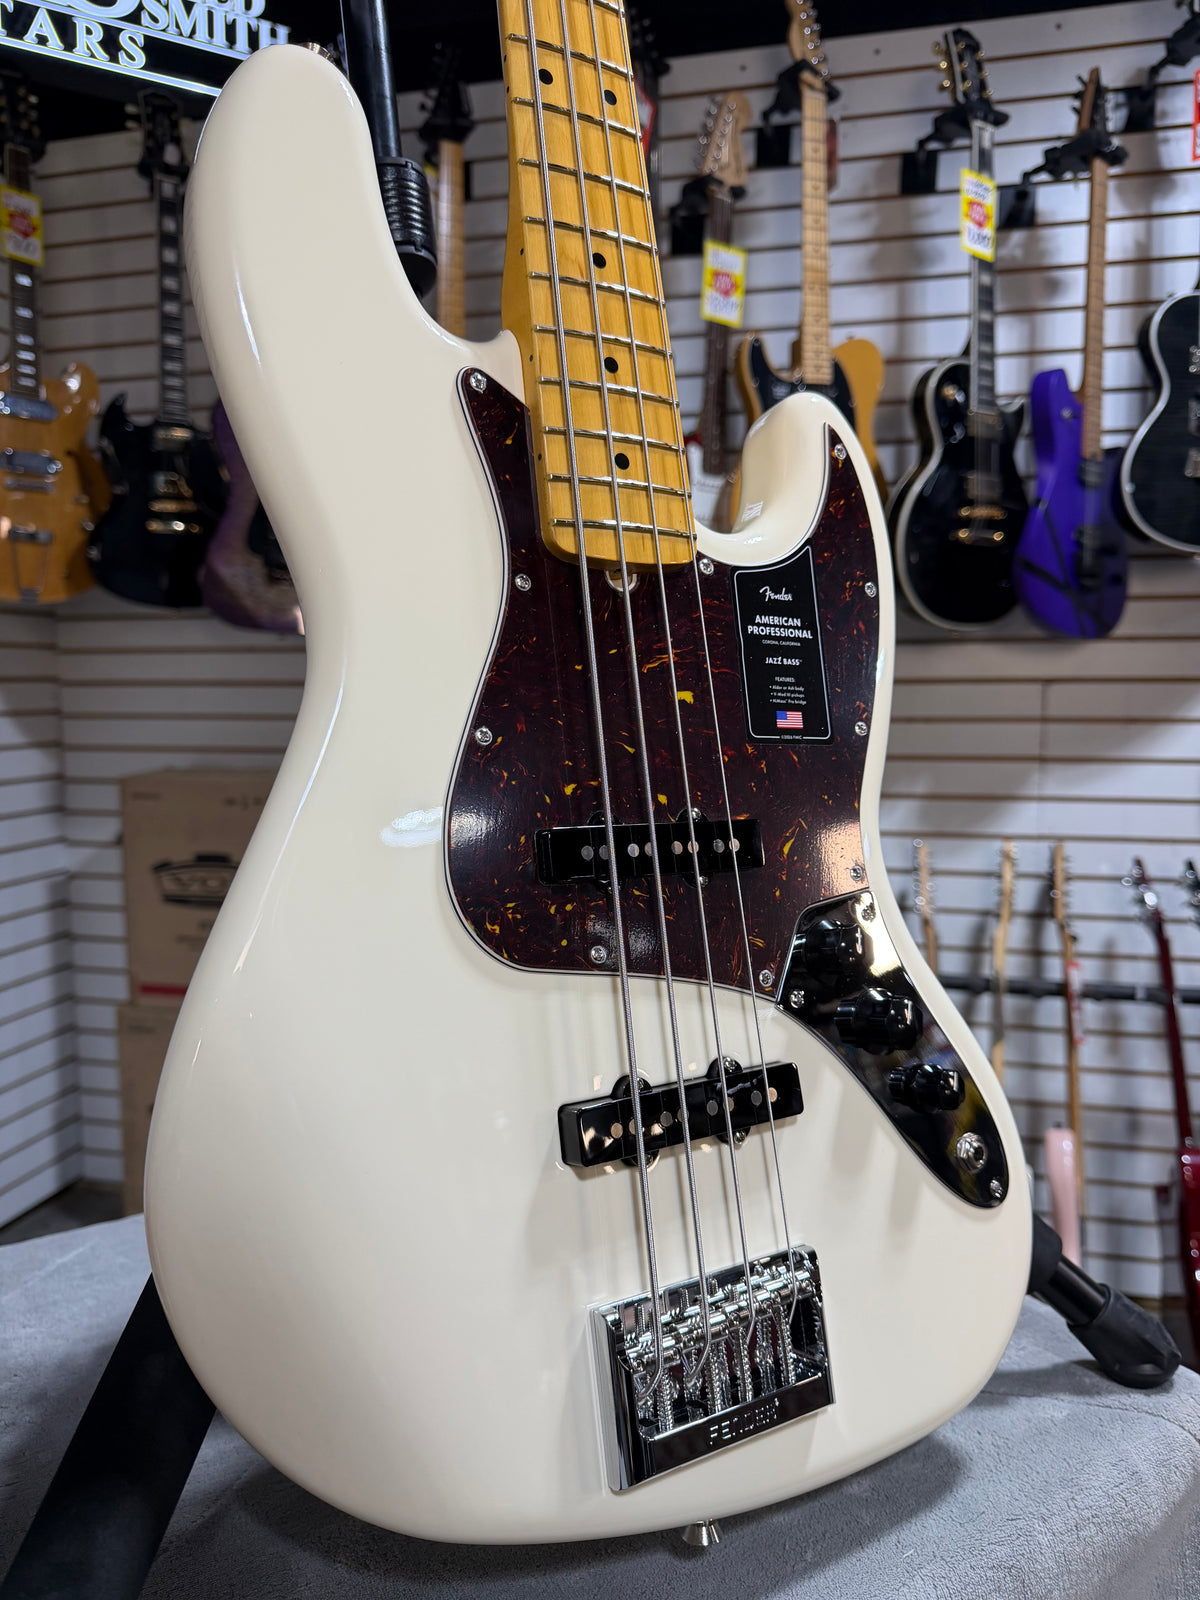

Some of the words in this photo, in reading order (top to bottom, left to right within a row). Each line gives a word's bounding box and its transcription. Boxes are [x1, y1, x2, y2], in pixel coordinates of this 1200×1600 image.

[141, 0, 291, 53] SMITH
[759, 585, 793, 602] Fender
[754, 614, 801, 627] AMERICAN
[747, 625, 813, 639] PROFESSIONAL
[765, 656, 782, 665] JAZZ
